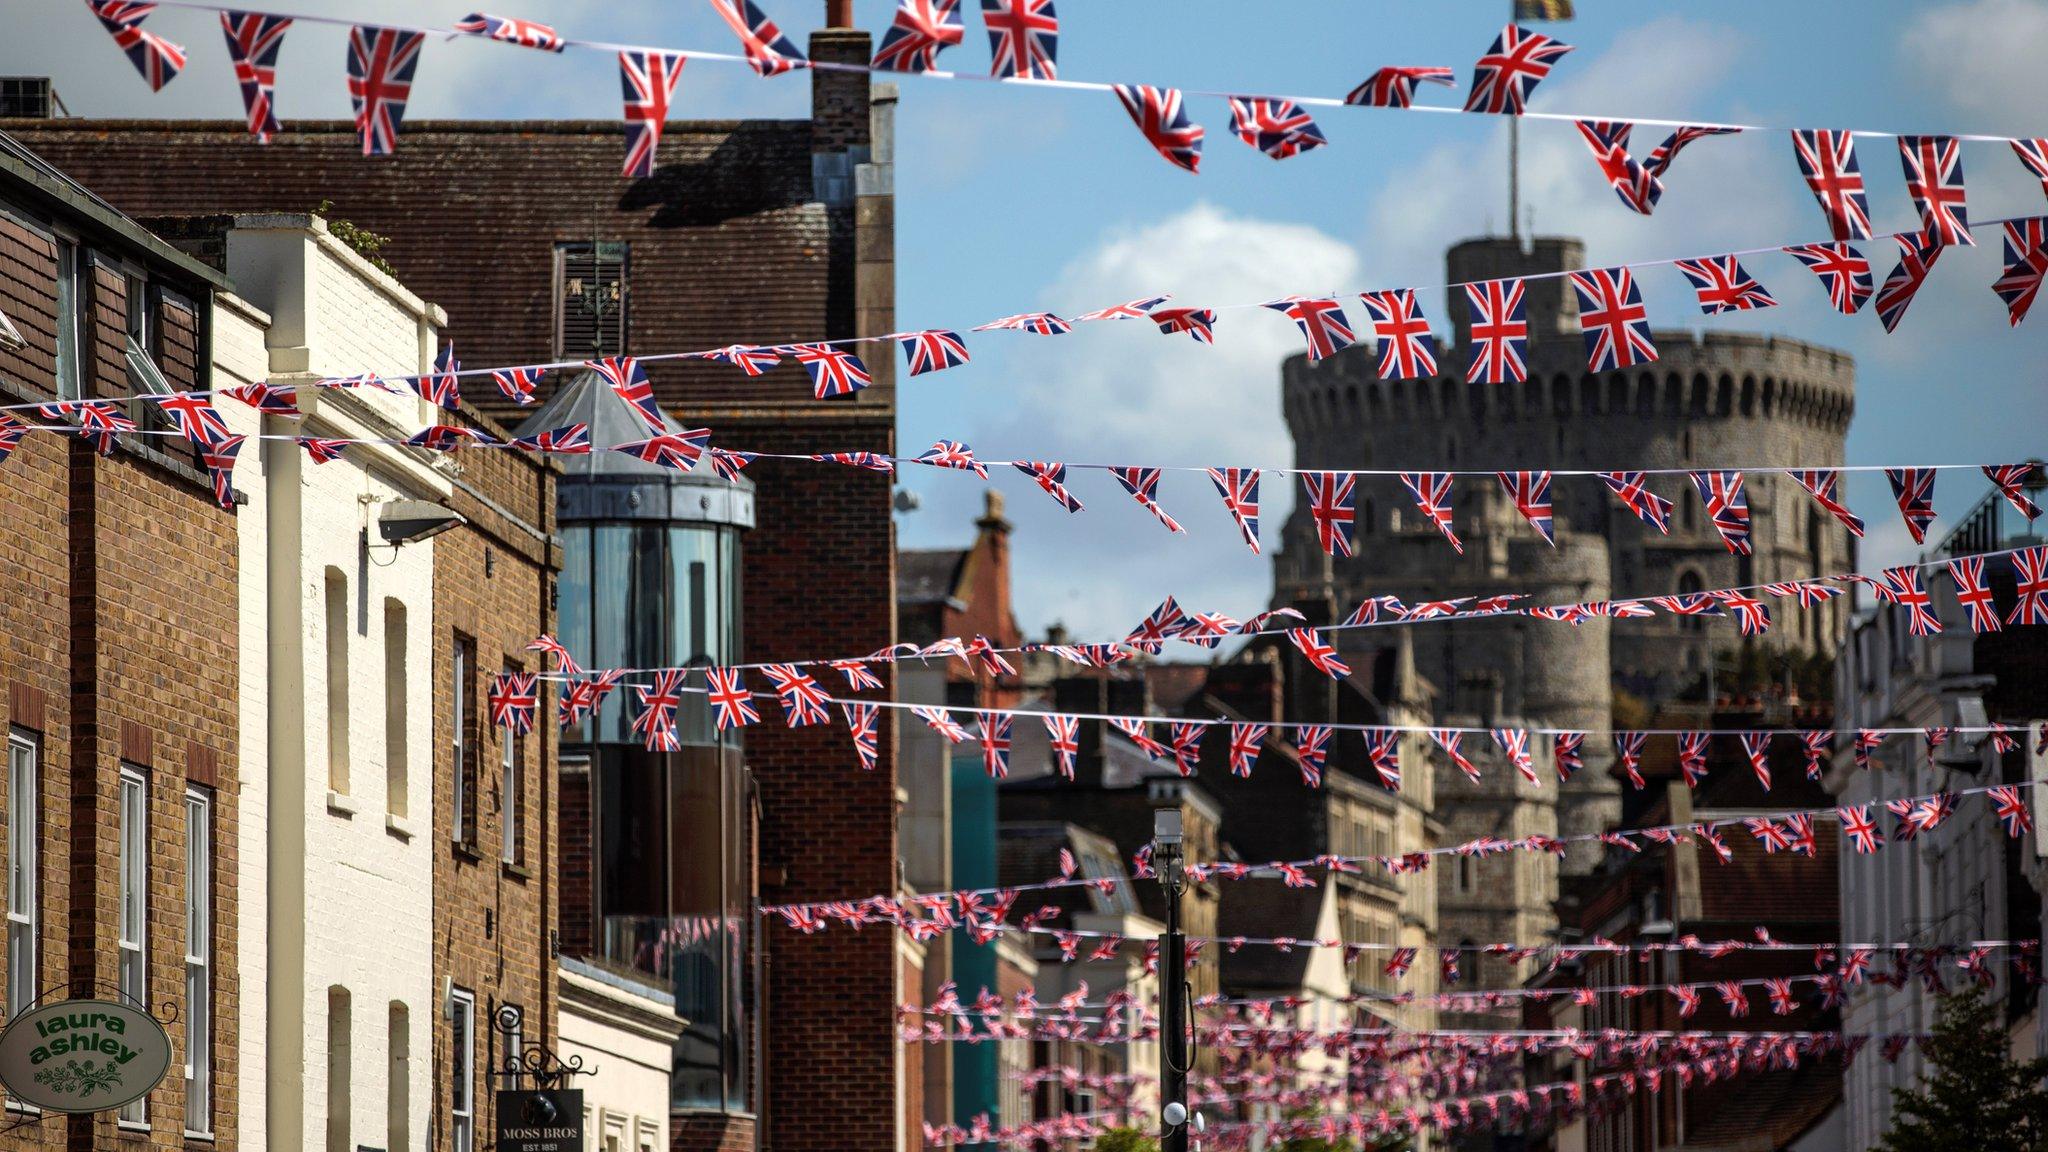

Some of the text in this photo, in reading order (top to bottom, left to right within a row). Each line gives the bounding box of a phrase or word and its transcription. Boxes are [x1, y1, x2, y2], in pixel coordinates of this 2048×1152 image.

[35, 1013, 126, 1038] laura
[29, 1032, 138, 1065] ashley
[503, 1128, 540, 1140] MOSS
[541, 1143, 558, 1152] 1851
